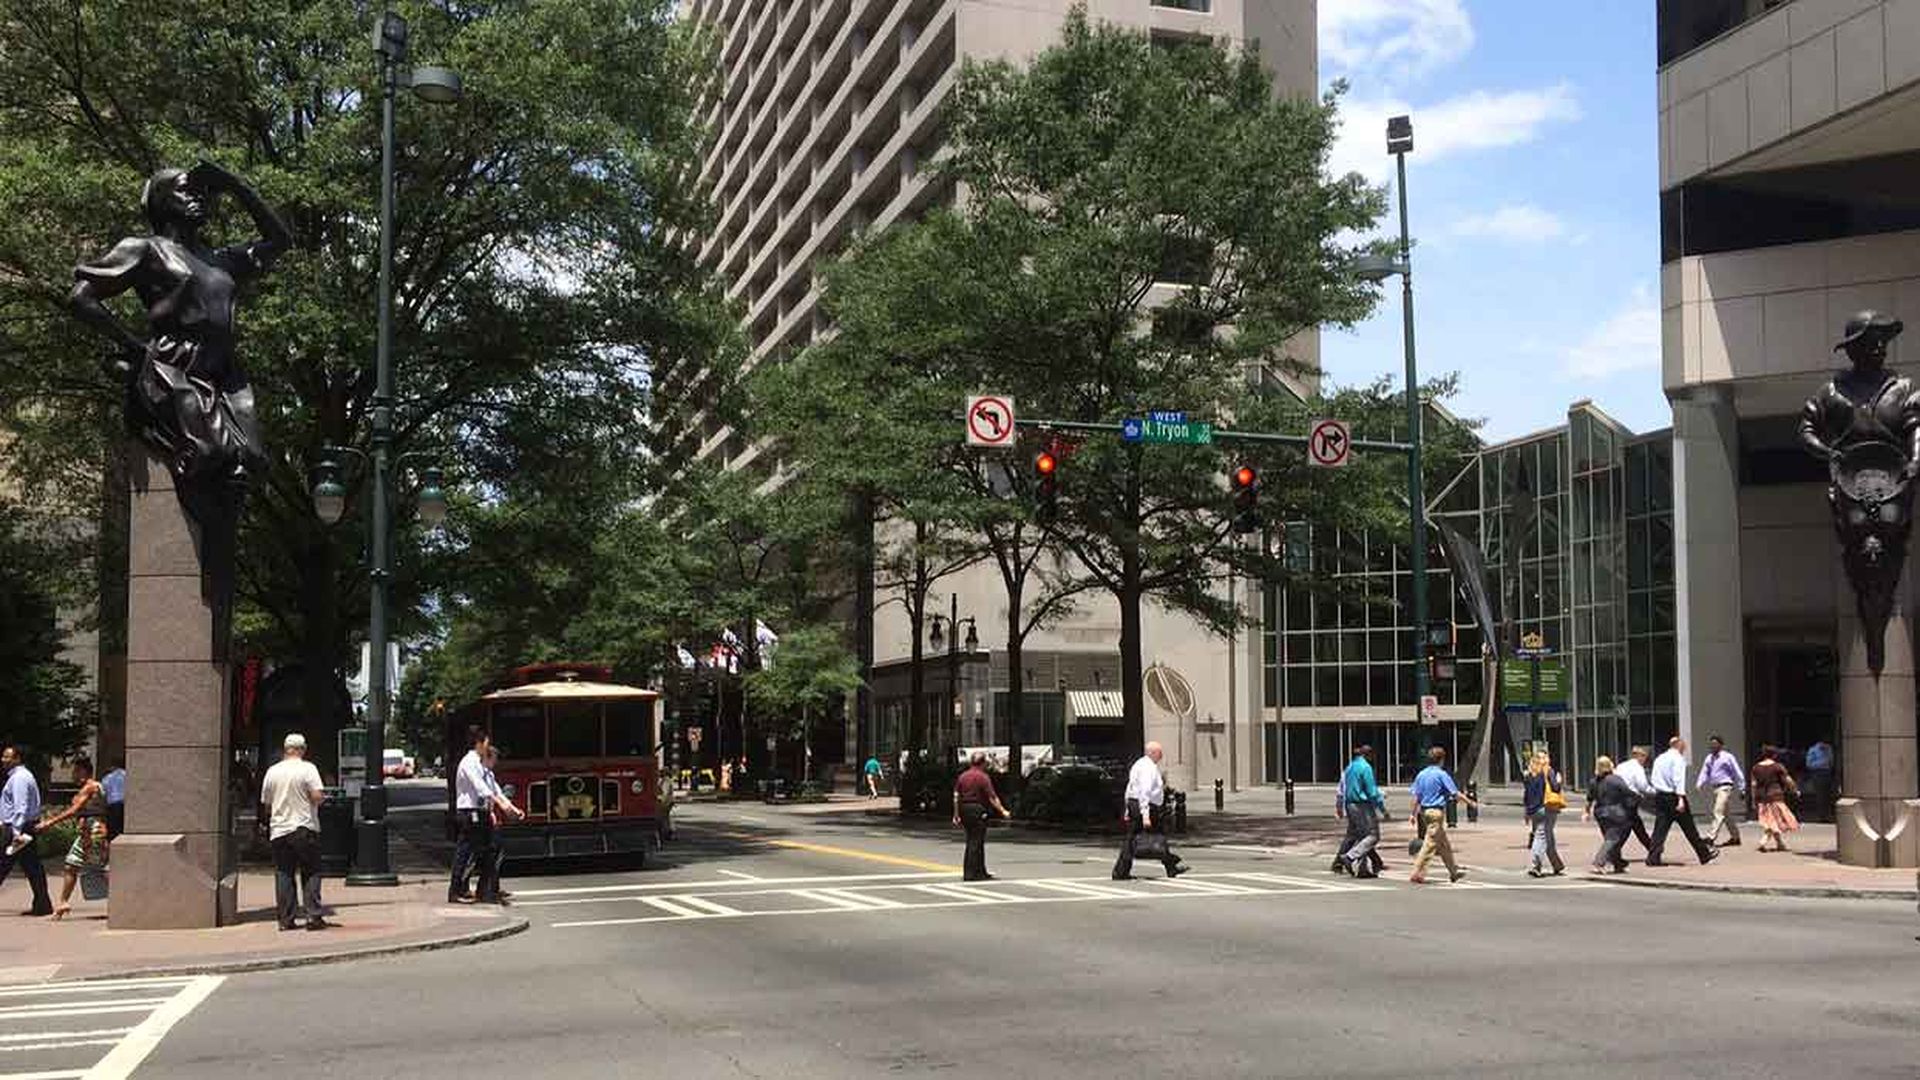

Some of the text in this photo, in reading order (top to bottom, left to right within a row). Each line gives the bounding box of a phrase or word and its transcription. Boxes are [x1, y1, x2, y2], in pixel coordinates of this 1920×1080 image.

[1153, 411, 1182, 422] WEST
[1142, 420, 1154, 436] N.
[1156, 421, 1189, 442] Tryon
